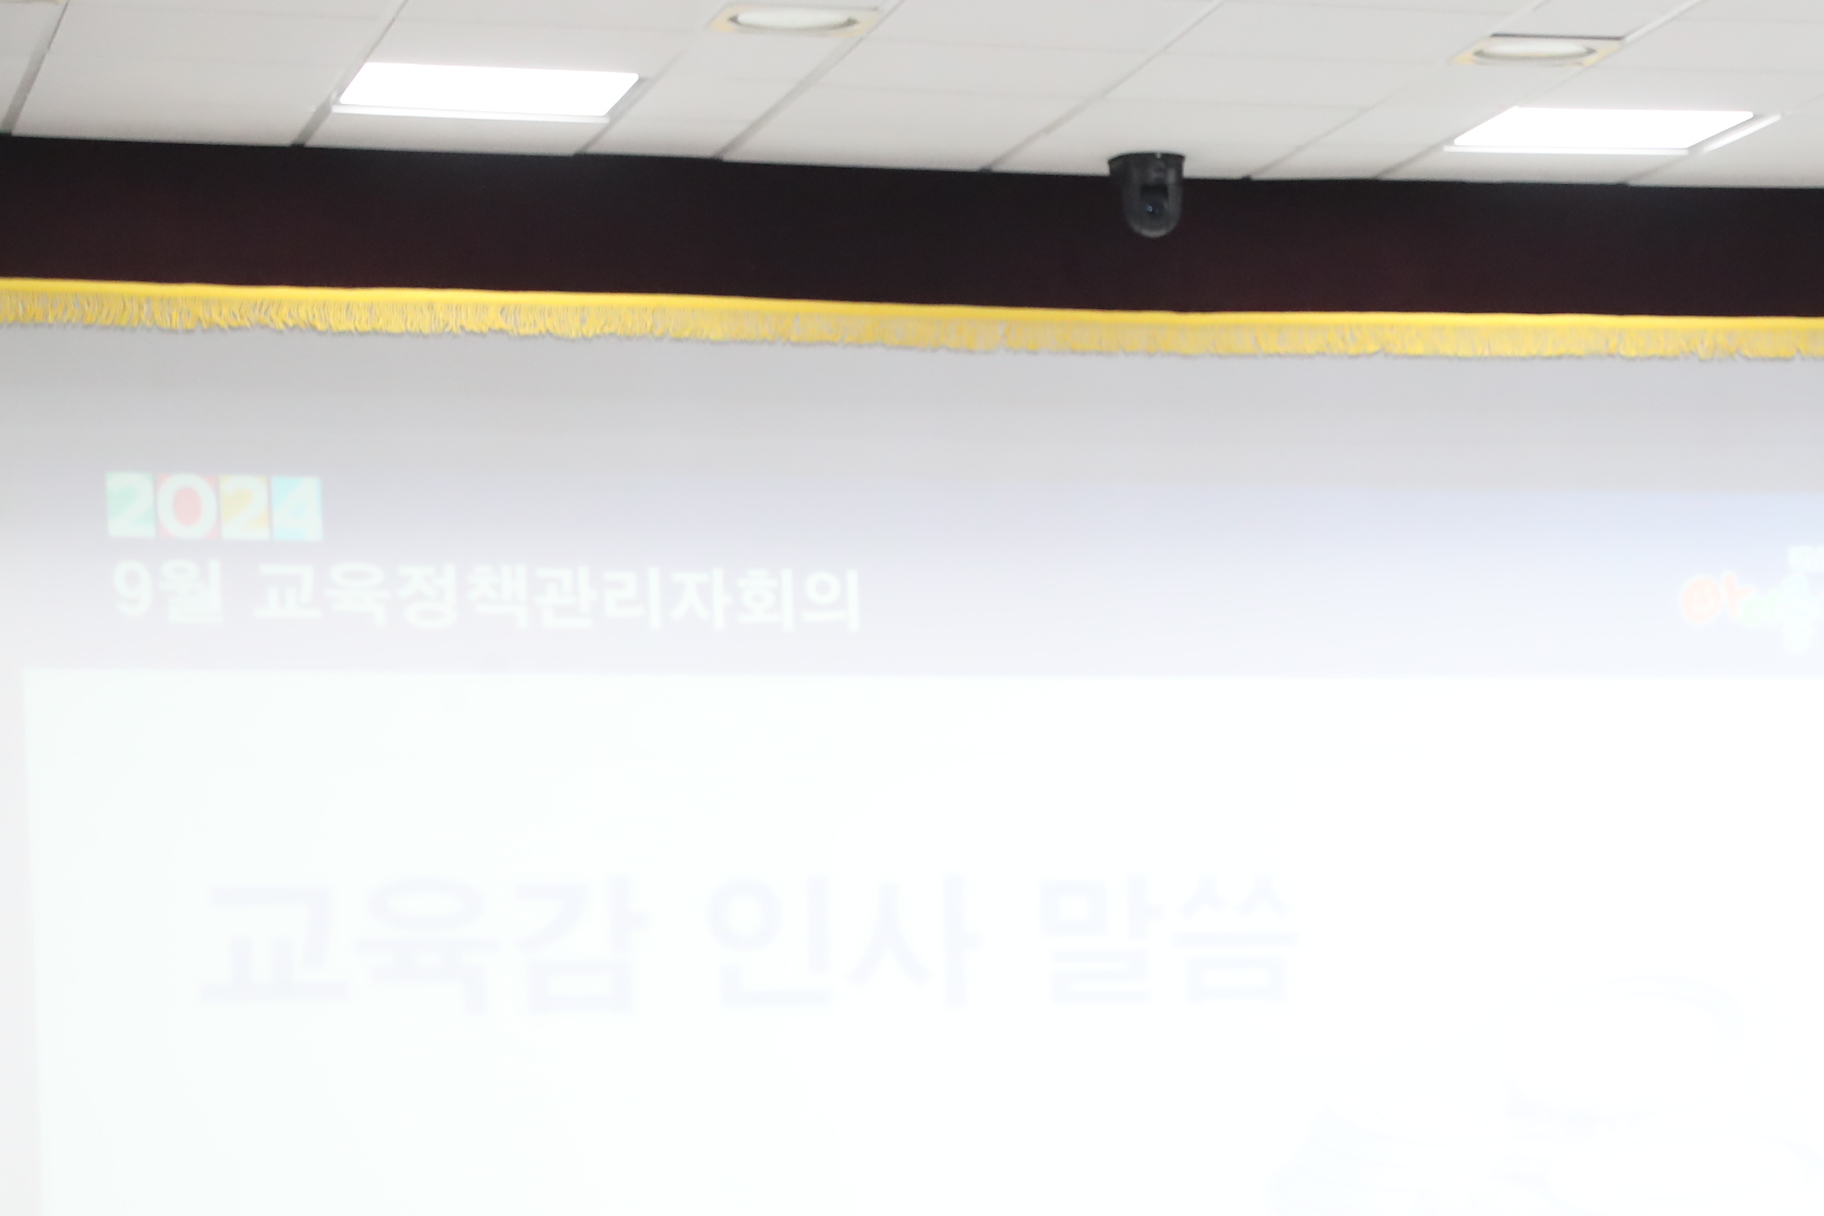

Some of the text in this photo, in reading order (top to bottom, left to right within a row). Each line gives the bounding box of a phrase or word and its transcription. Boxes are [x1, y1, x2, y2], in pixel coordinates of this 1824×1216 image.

[107, 471, 323, 543] 2024
[112, 559, 862, 633] 9월 교육정책관리자회의
[194, 871, 1302, 1017] 교육감 인사 말씀
